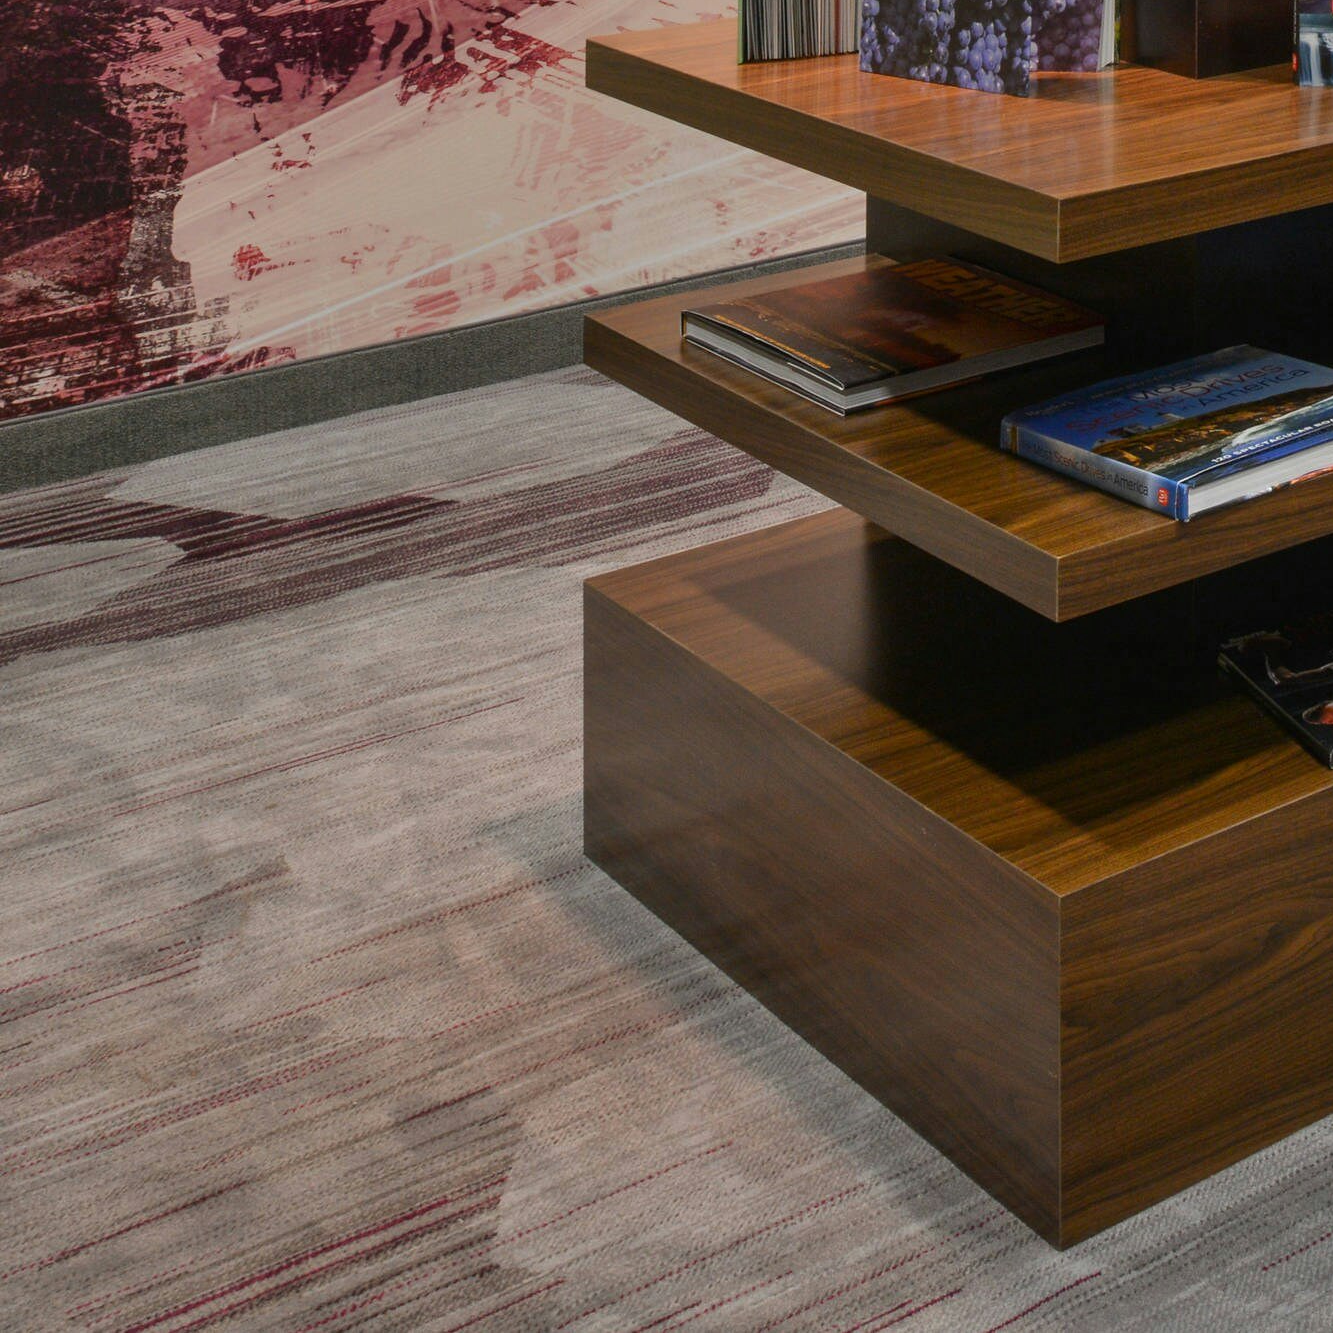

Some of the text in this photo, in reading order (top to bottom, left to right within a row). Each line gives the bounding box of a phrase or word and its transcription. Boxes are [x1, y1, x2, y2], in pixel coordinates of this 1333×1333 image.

[1180, 363, 1284, 398] Drives
[1199, 368, 1310, 407] America
[1211, 451, 1232, 464] 120
[1233, 426, 1312, 457] SPECTACULAR
[1054, 450, 1080, 469] Scenic
[1113, 474, 1149, 496] America
